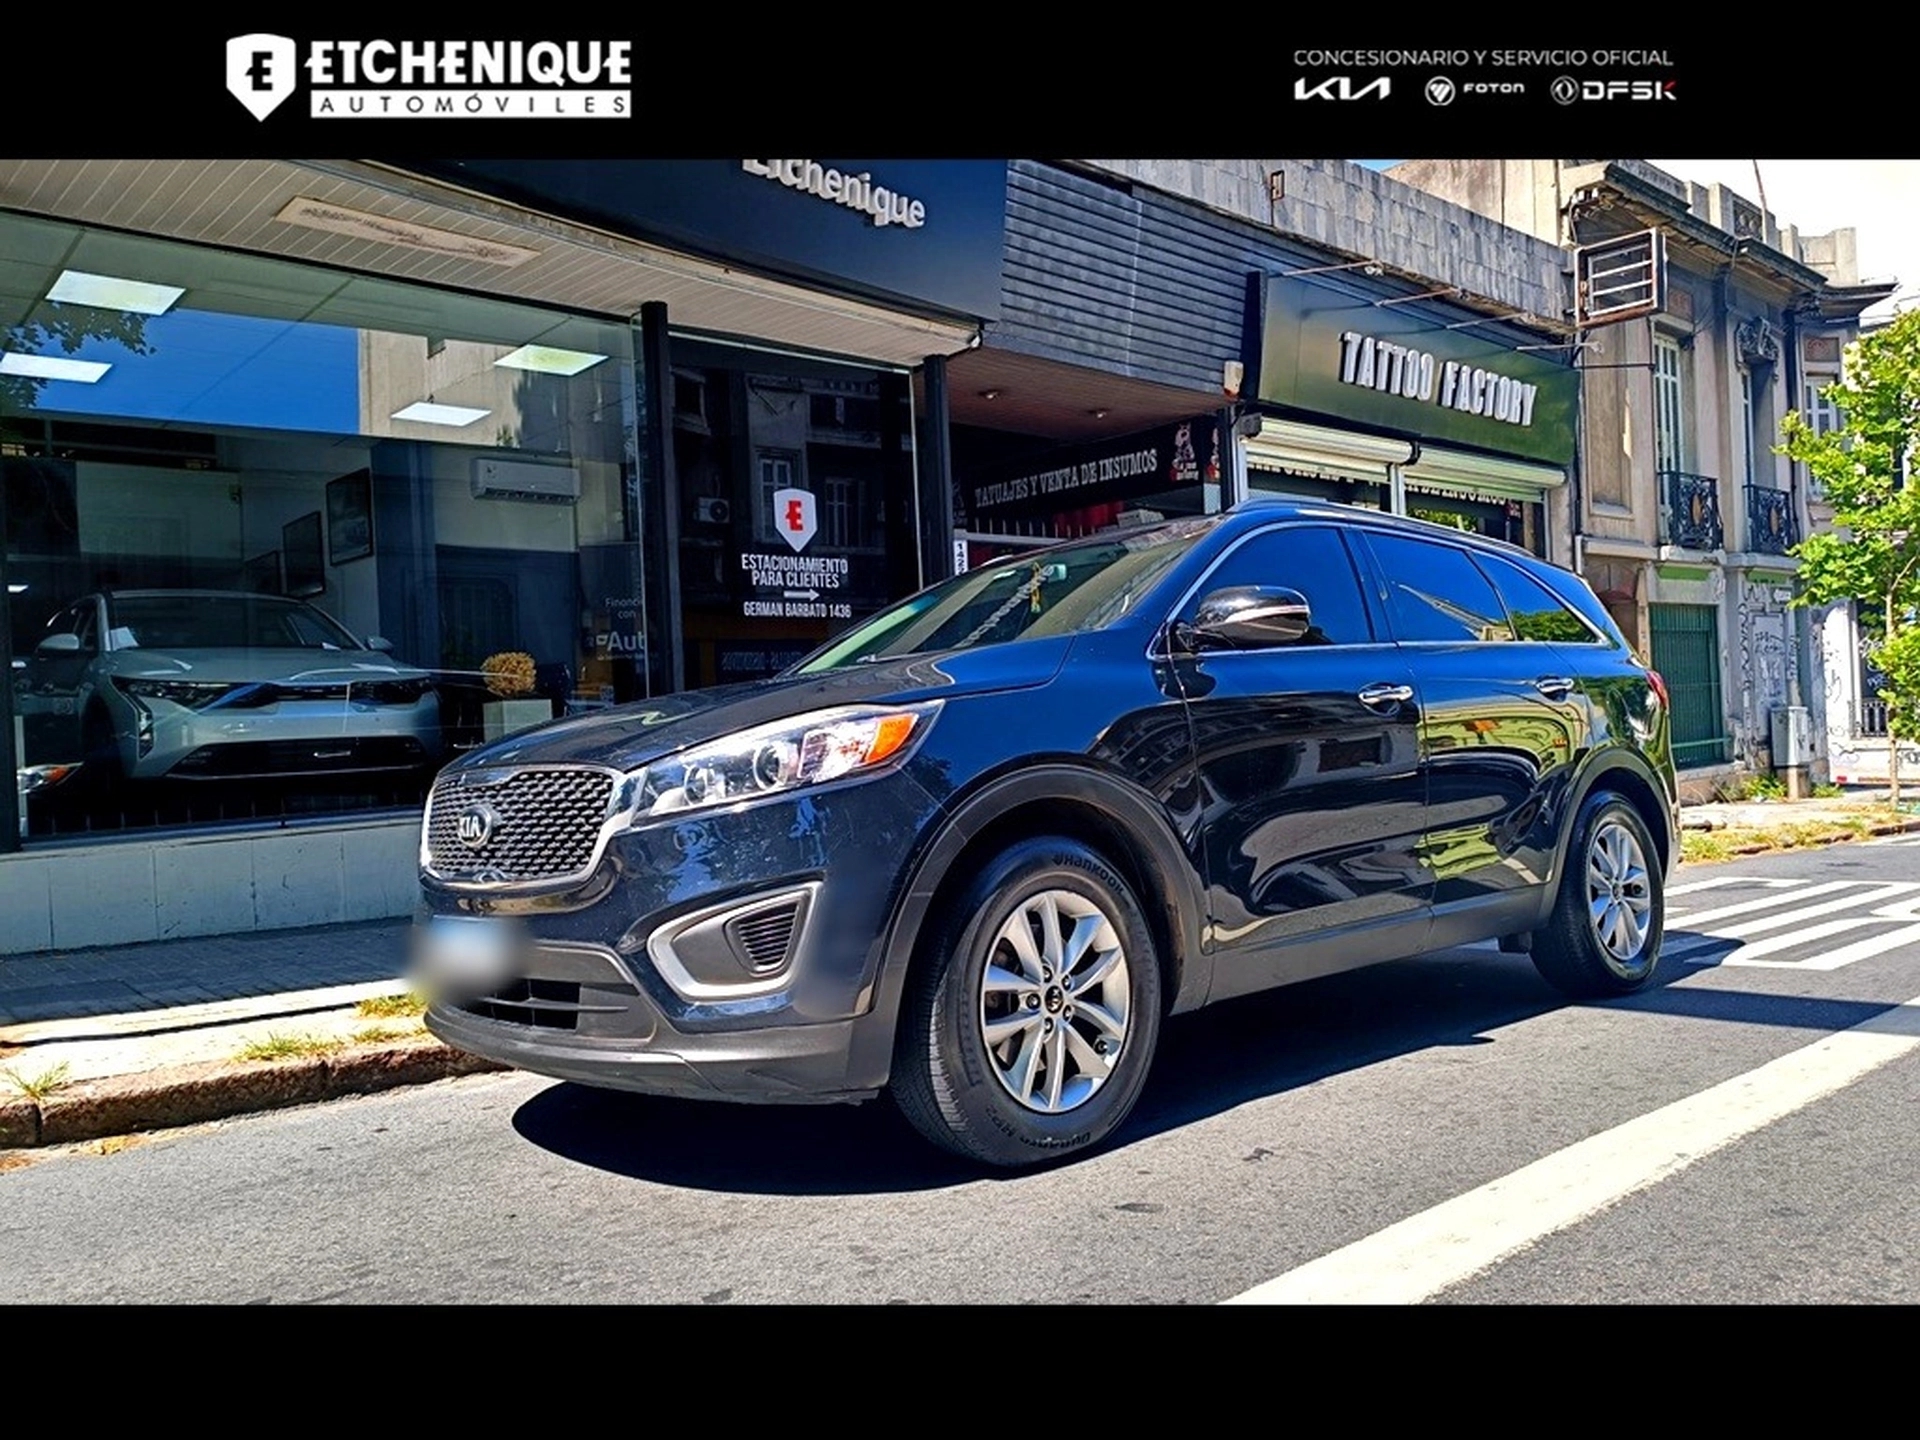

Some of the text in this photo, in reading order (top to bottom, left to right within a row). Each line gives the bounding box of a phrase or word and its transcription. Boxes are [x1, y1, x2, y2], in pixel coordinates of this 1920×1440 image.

[1339, 331, 1537, 427] TATTOO FACTORY
[975, 480, 1030, 508] TATUAJES
[1030, 477, 1038, 497] Y
[1039, 464, 1080, 495] VENTA
[1081, 462, 1098, 486] DE
[1099, 448, 1158, 481] INSUMOS
[741, 553, 849, 574] ESTACIONAMIENTO
[751, 570, 840, 588] PARA CLIENTES
[743, 601, 852, 618] GERMAN BARBATO 1436
[607, 631, 645, 652] Aut
